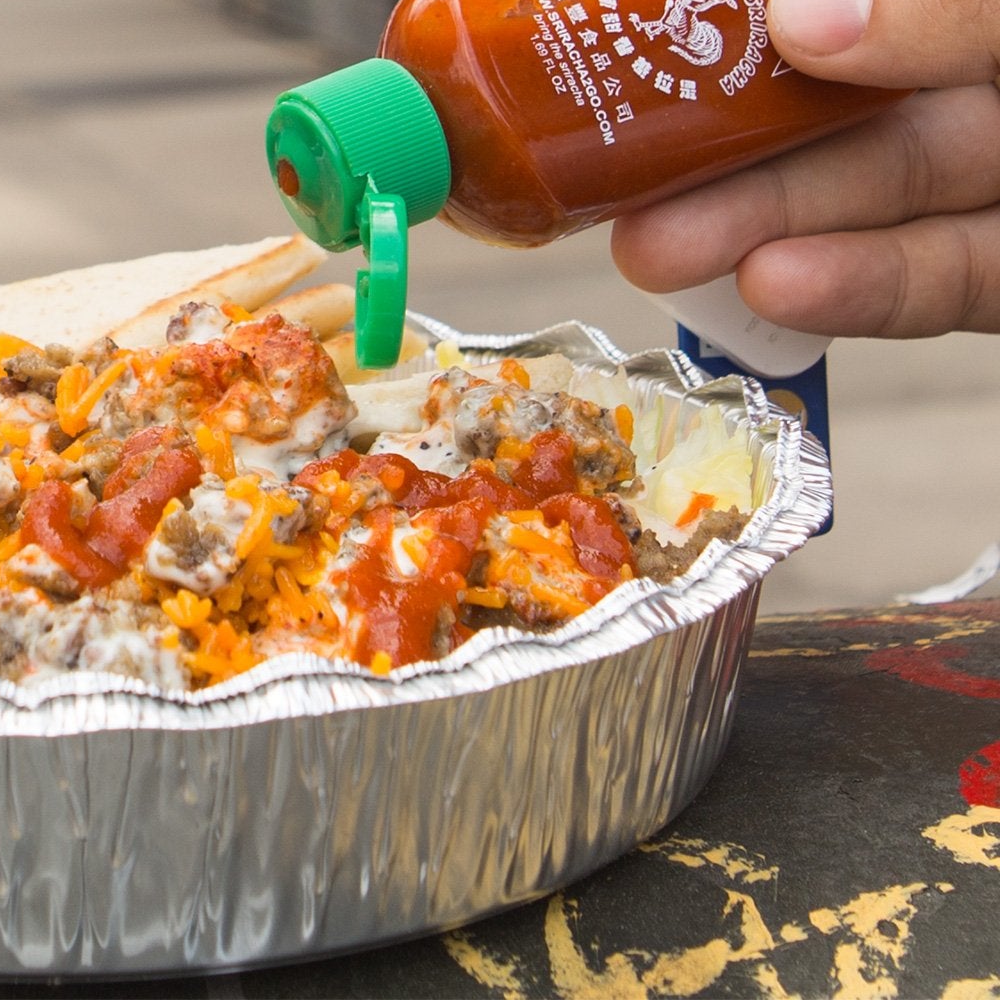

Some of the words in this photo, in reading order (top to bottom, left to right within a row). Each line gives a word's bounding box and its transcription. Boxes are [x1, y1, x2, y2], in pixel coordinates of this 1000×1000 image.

[530, 33, 549, 57] 1.69
[542, 57, 556, 75] FL
[551, 75, 567, 95] OZ
[533, 13, 554, 42] bring
[549, 42, 564, 60] the
[558, 61, 585, 107] sriracha
